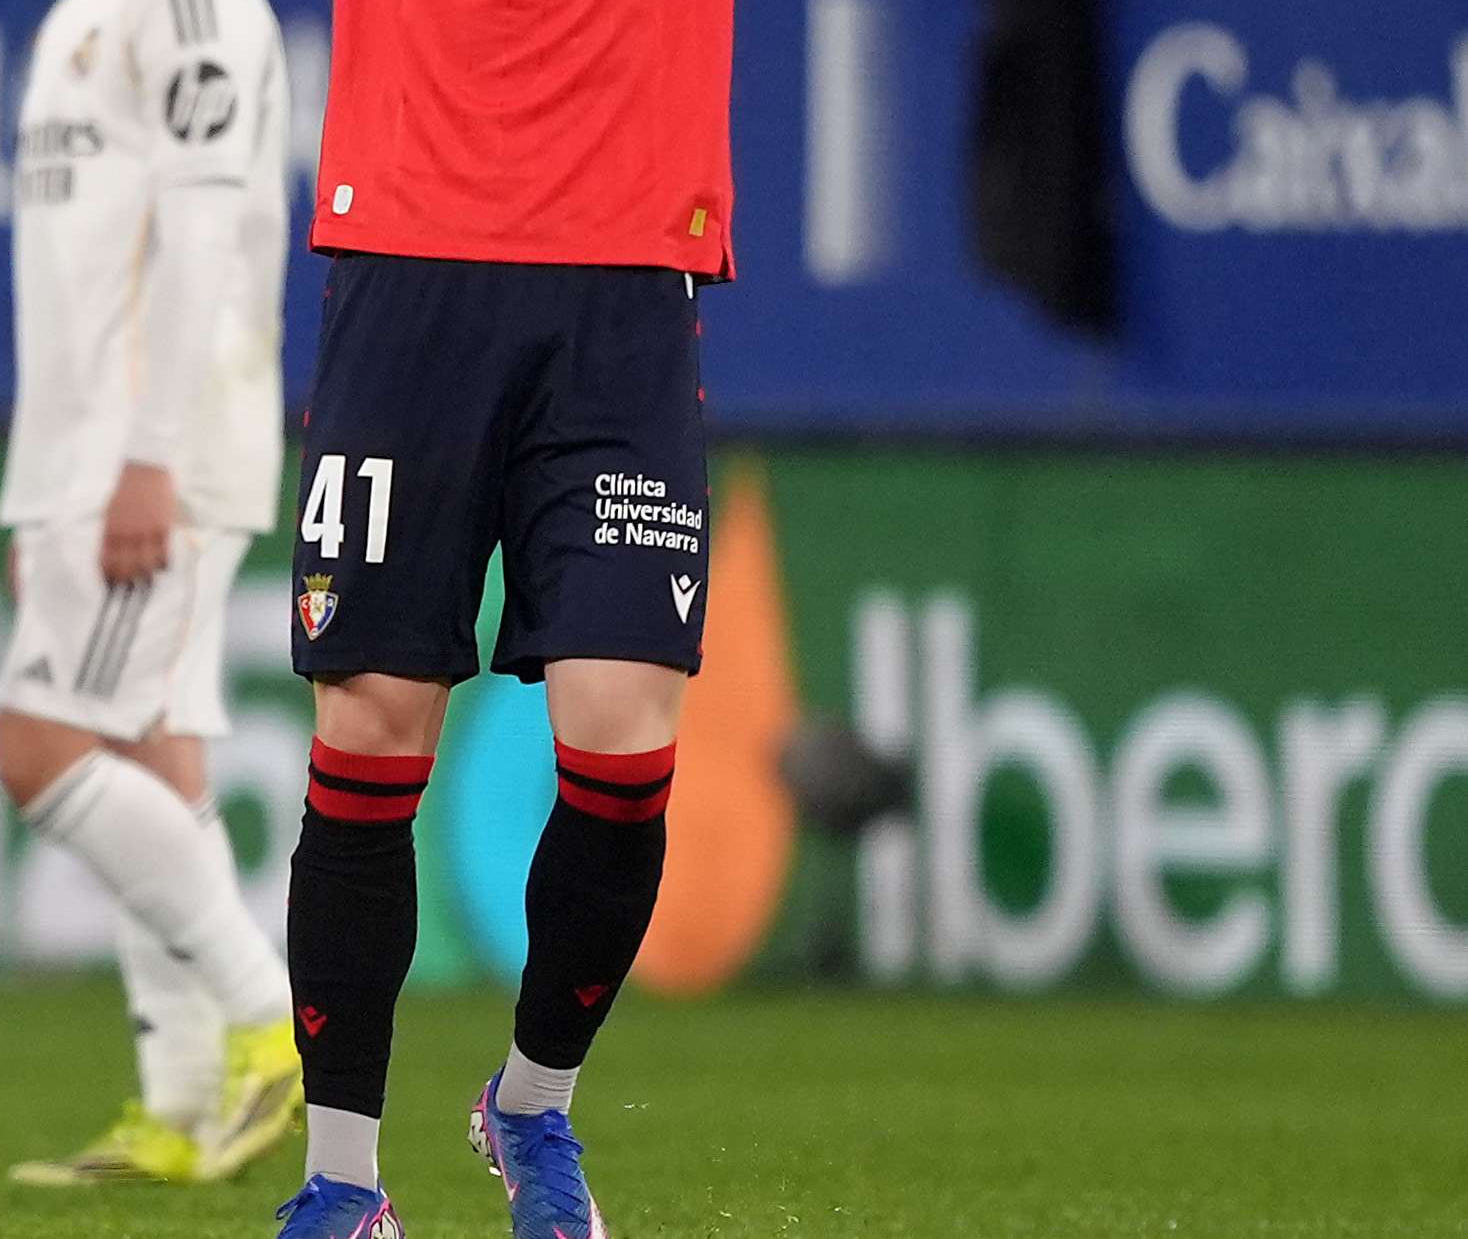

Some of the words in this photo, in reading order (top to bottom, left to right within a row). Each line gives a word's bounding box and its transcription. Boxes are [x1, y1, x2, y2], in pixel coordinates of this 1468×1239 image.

[1125, 20, 1468, 234] Caixa
[595, 473, 666, 497] Clínica
[301, 455, 393, 563] 41
[595, 498, 702, 530] Universidad
[594, 522, 619, 544] de
[625, 522, 699, 554] Navarra
